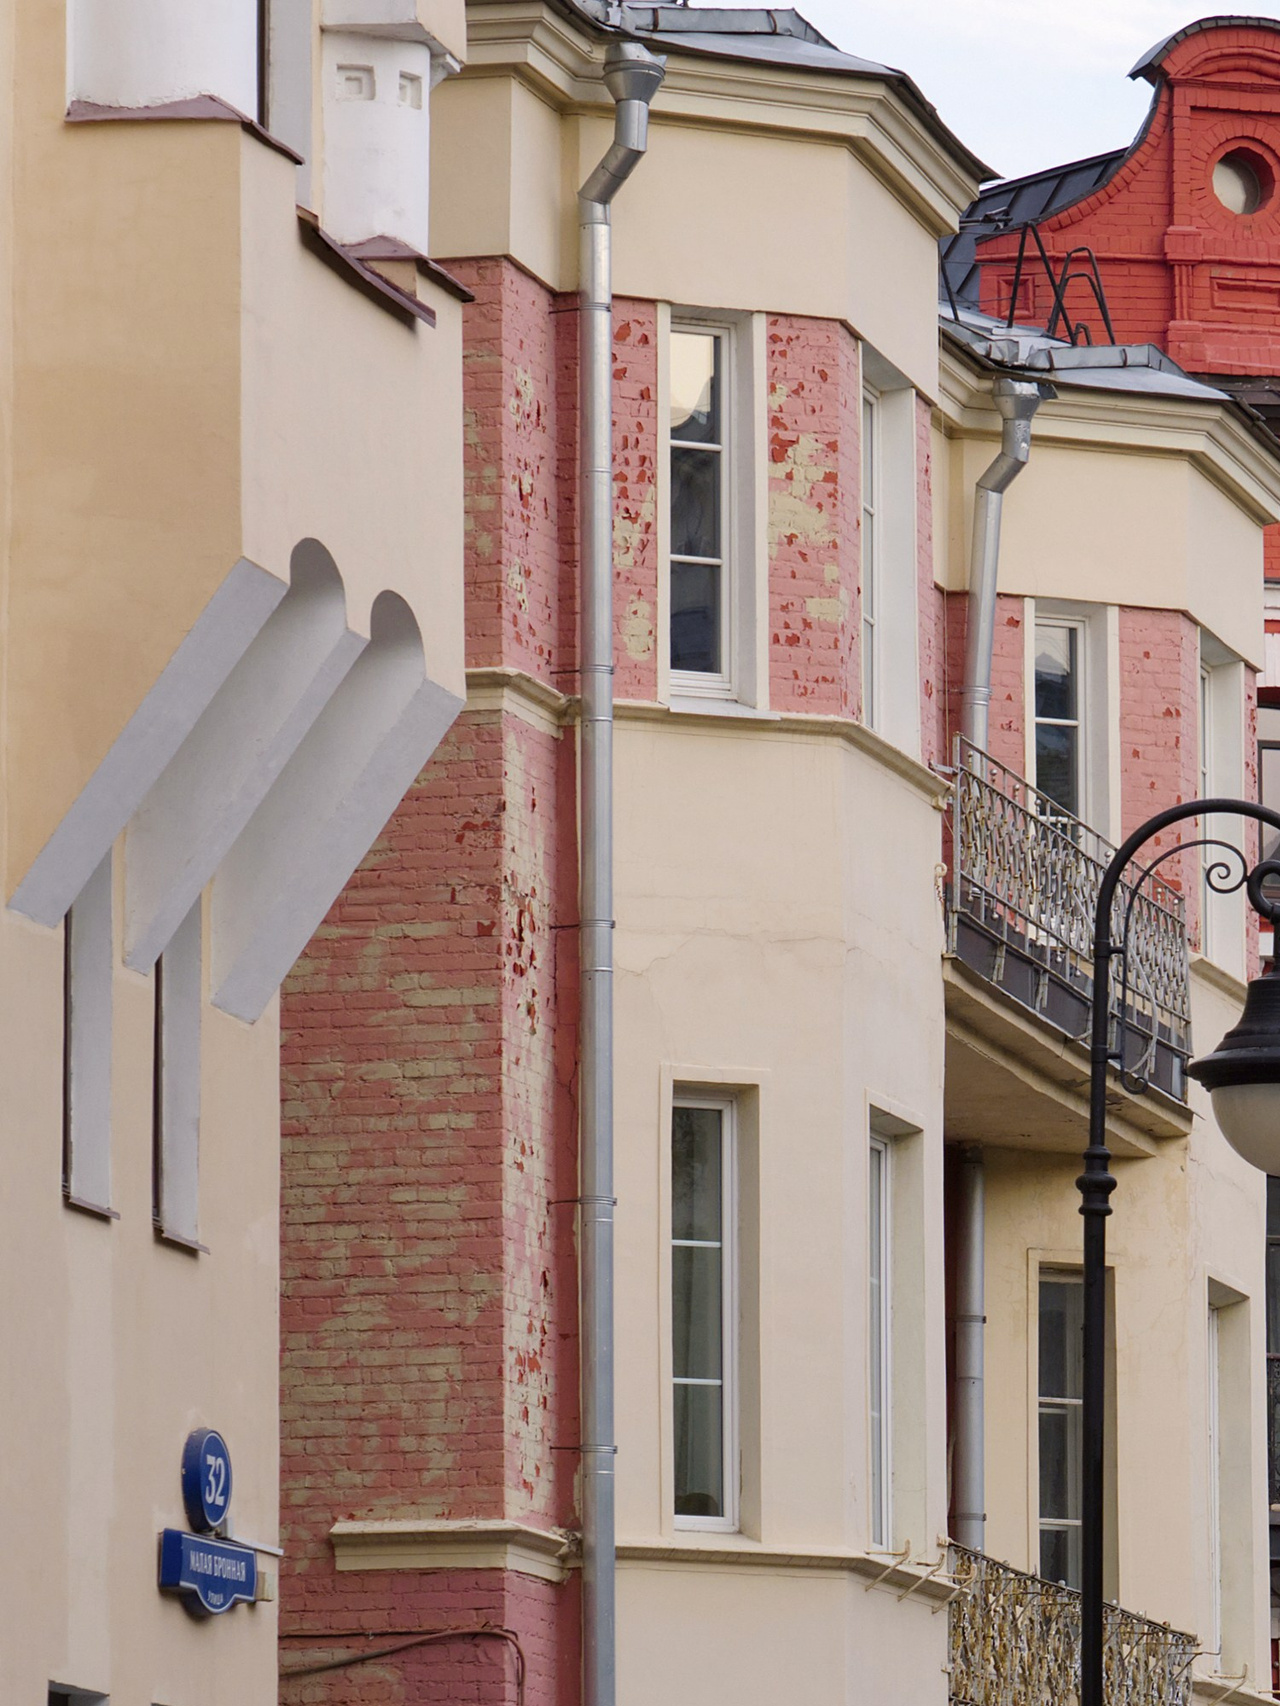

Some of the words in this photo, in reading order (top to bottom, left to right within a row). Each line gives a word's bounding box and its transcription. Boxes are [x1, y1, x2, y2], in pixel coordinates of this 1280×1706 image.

[205, 1454, 225, 1506] 32
[190, 1550, 212, 1575] МАЛАЯ
[214, 1556, 246, 1582] БРОННАЯ
[207, 1590, 224, 1605] УЛИЦА
